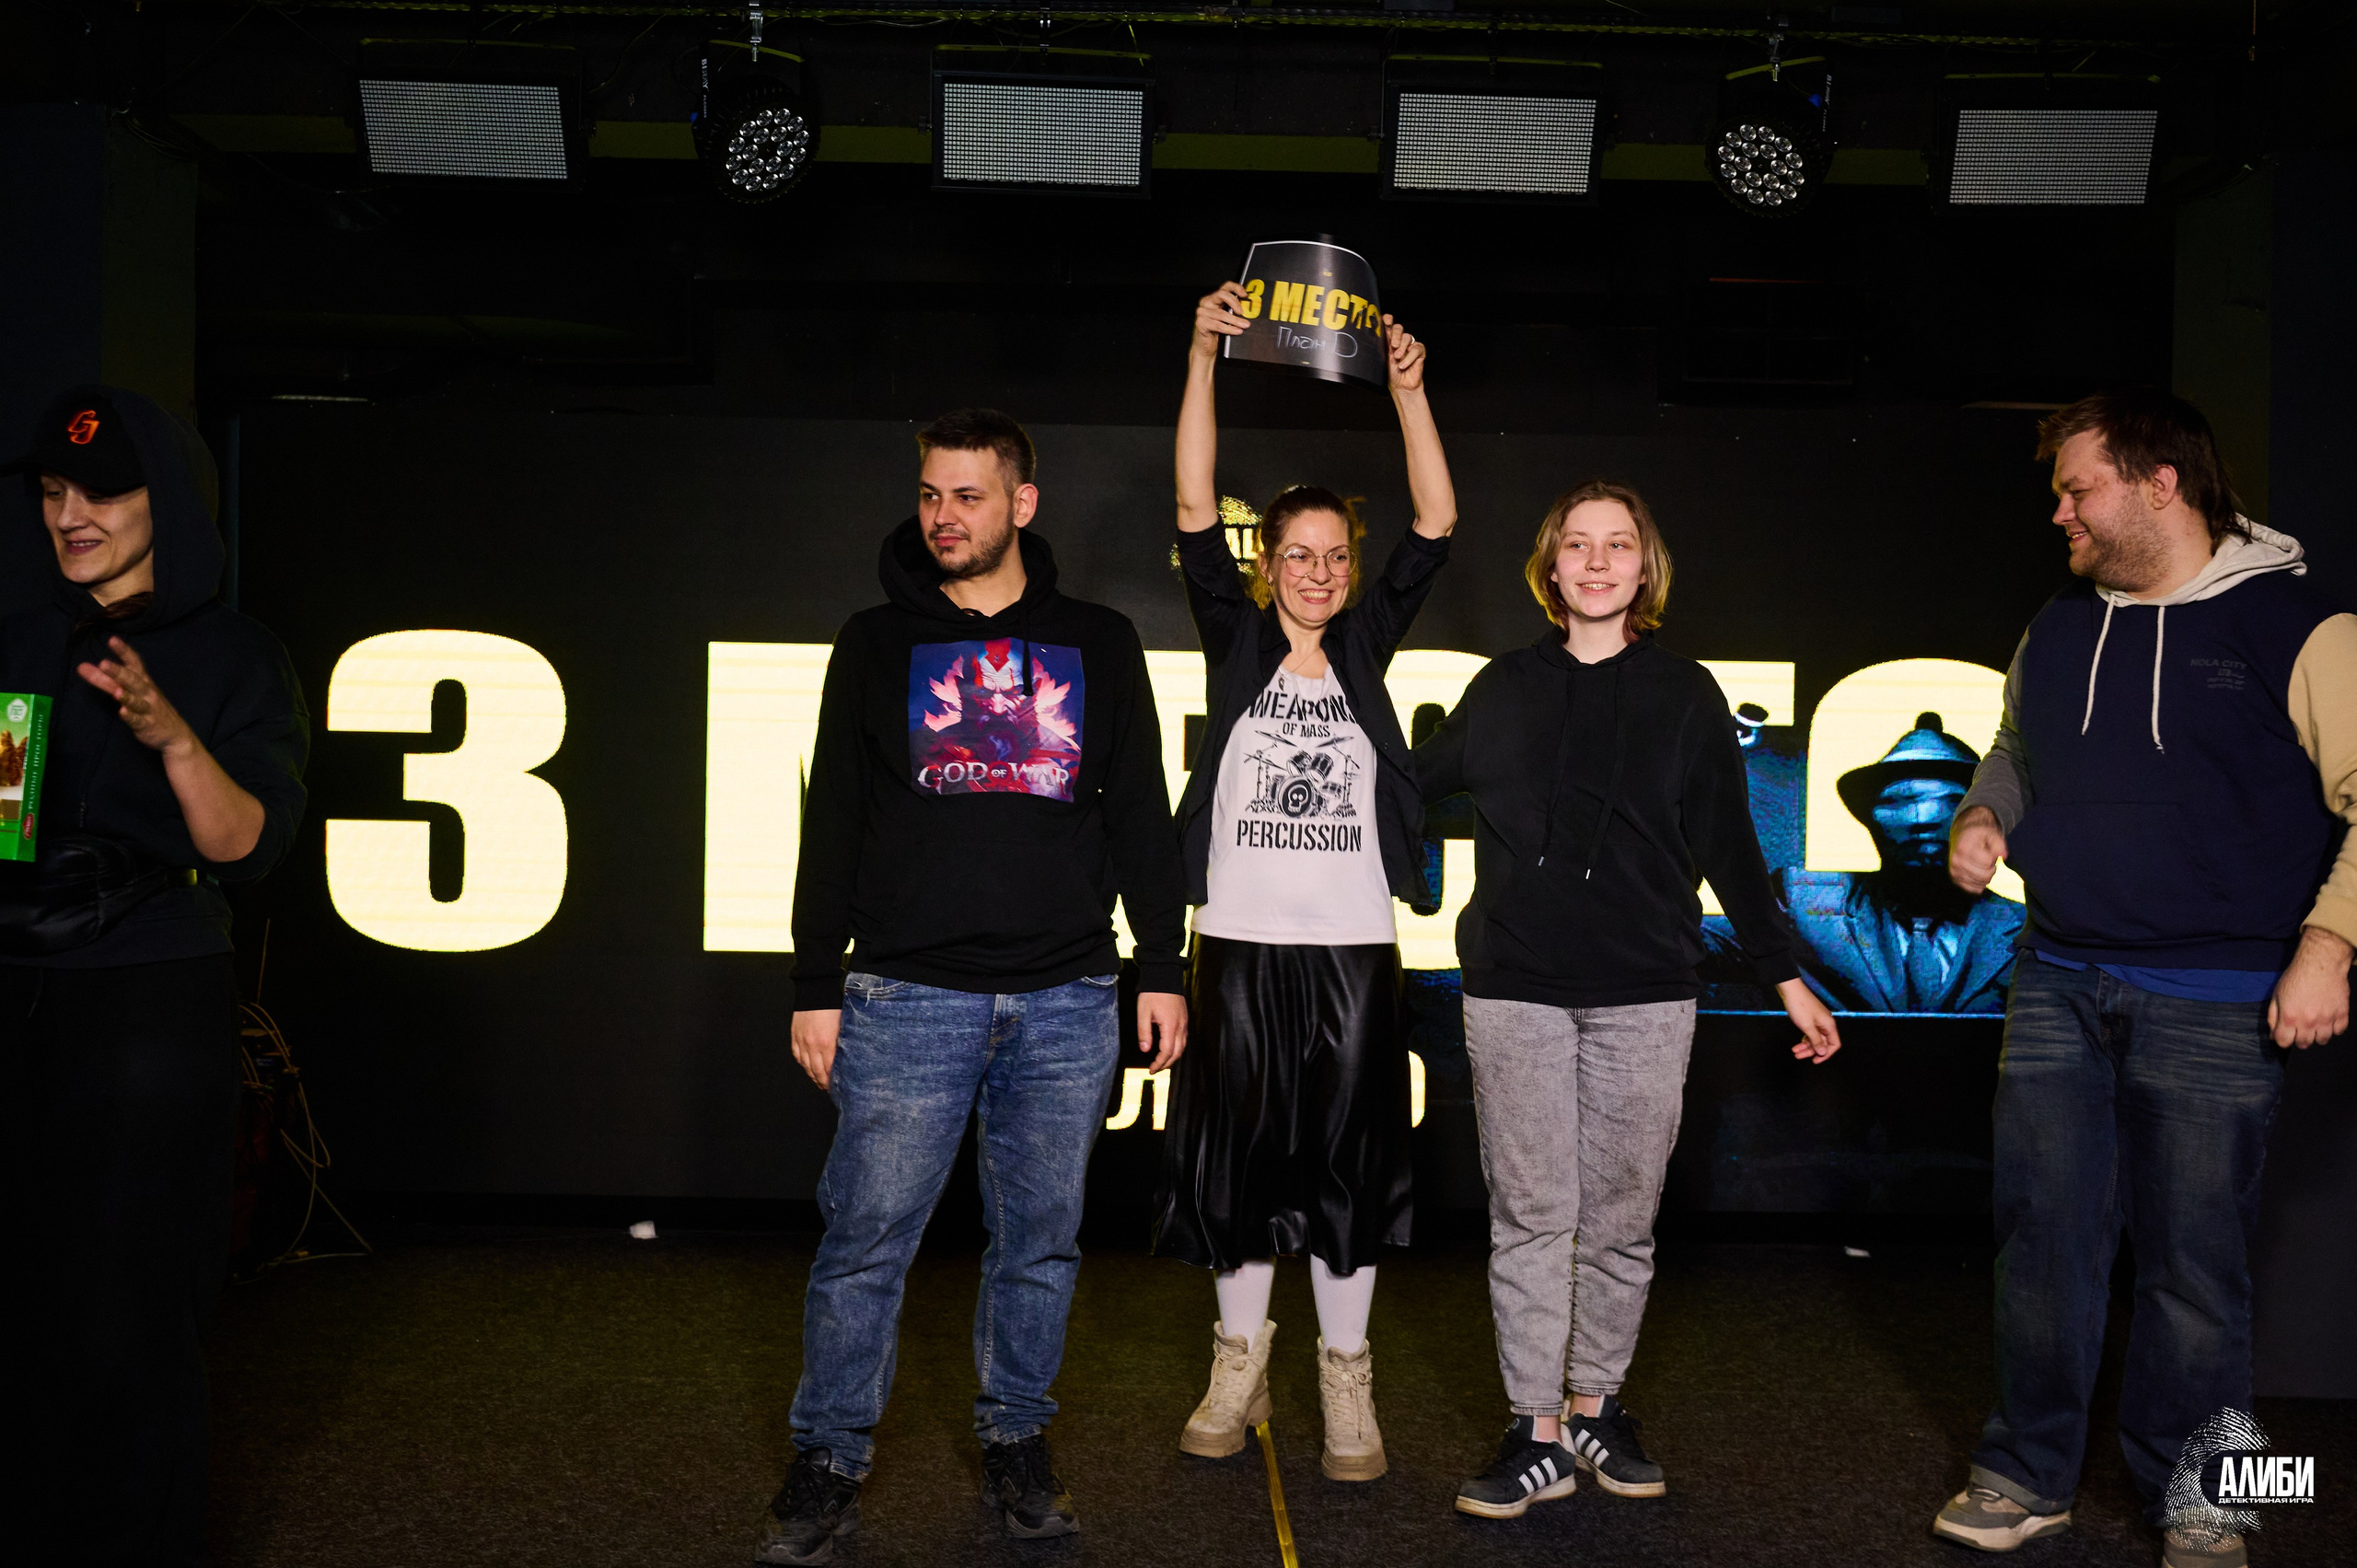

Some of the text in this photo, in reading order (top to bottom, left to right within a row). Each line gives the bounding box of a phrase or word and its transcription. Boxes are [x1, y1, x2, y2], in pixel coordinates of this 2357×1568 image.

[1241, 279, 1265, 319] 3
[1277, 326, 1326, 349] План
[1248, 690, 1356, 724] WEAPON
[1283, 722, 1330, 738] OF MASS
[326, 630, 568, 952] 3
[917, 761, 988, 795] GOD
[1008, 762, 1070, 796] WAR
[1237, 819, 1362, 852] PERCUSSION
